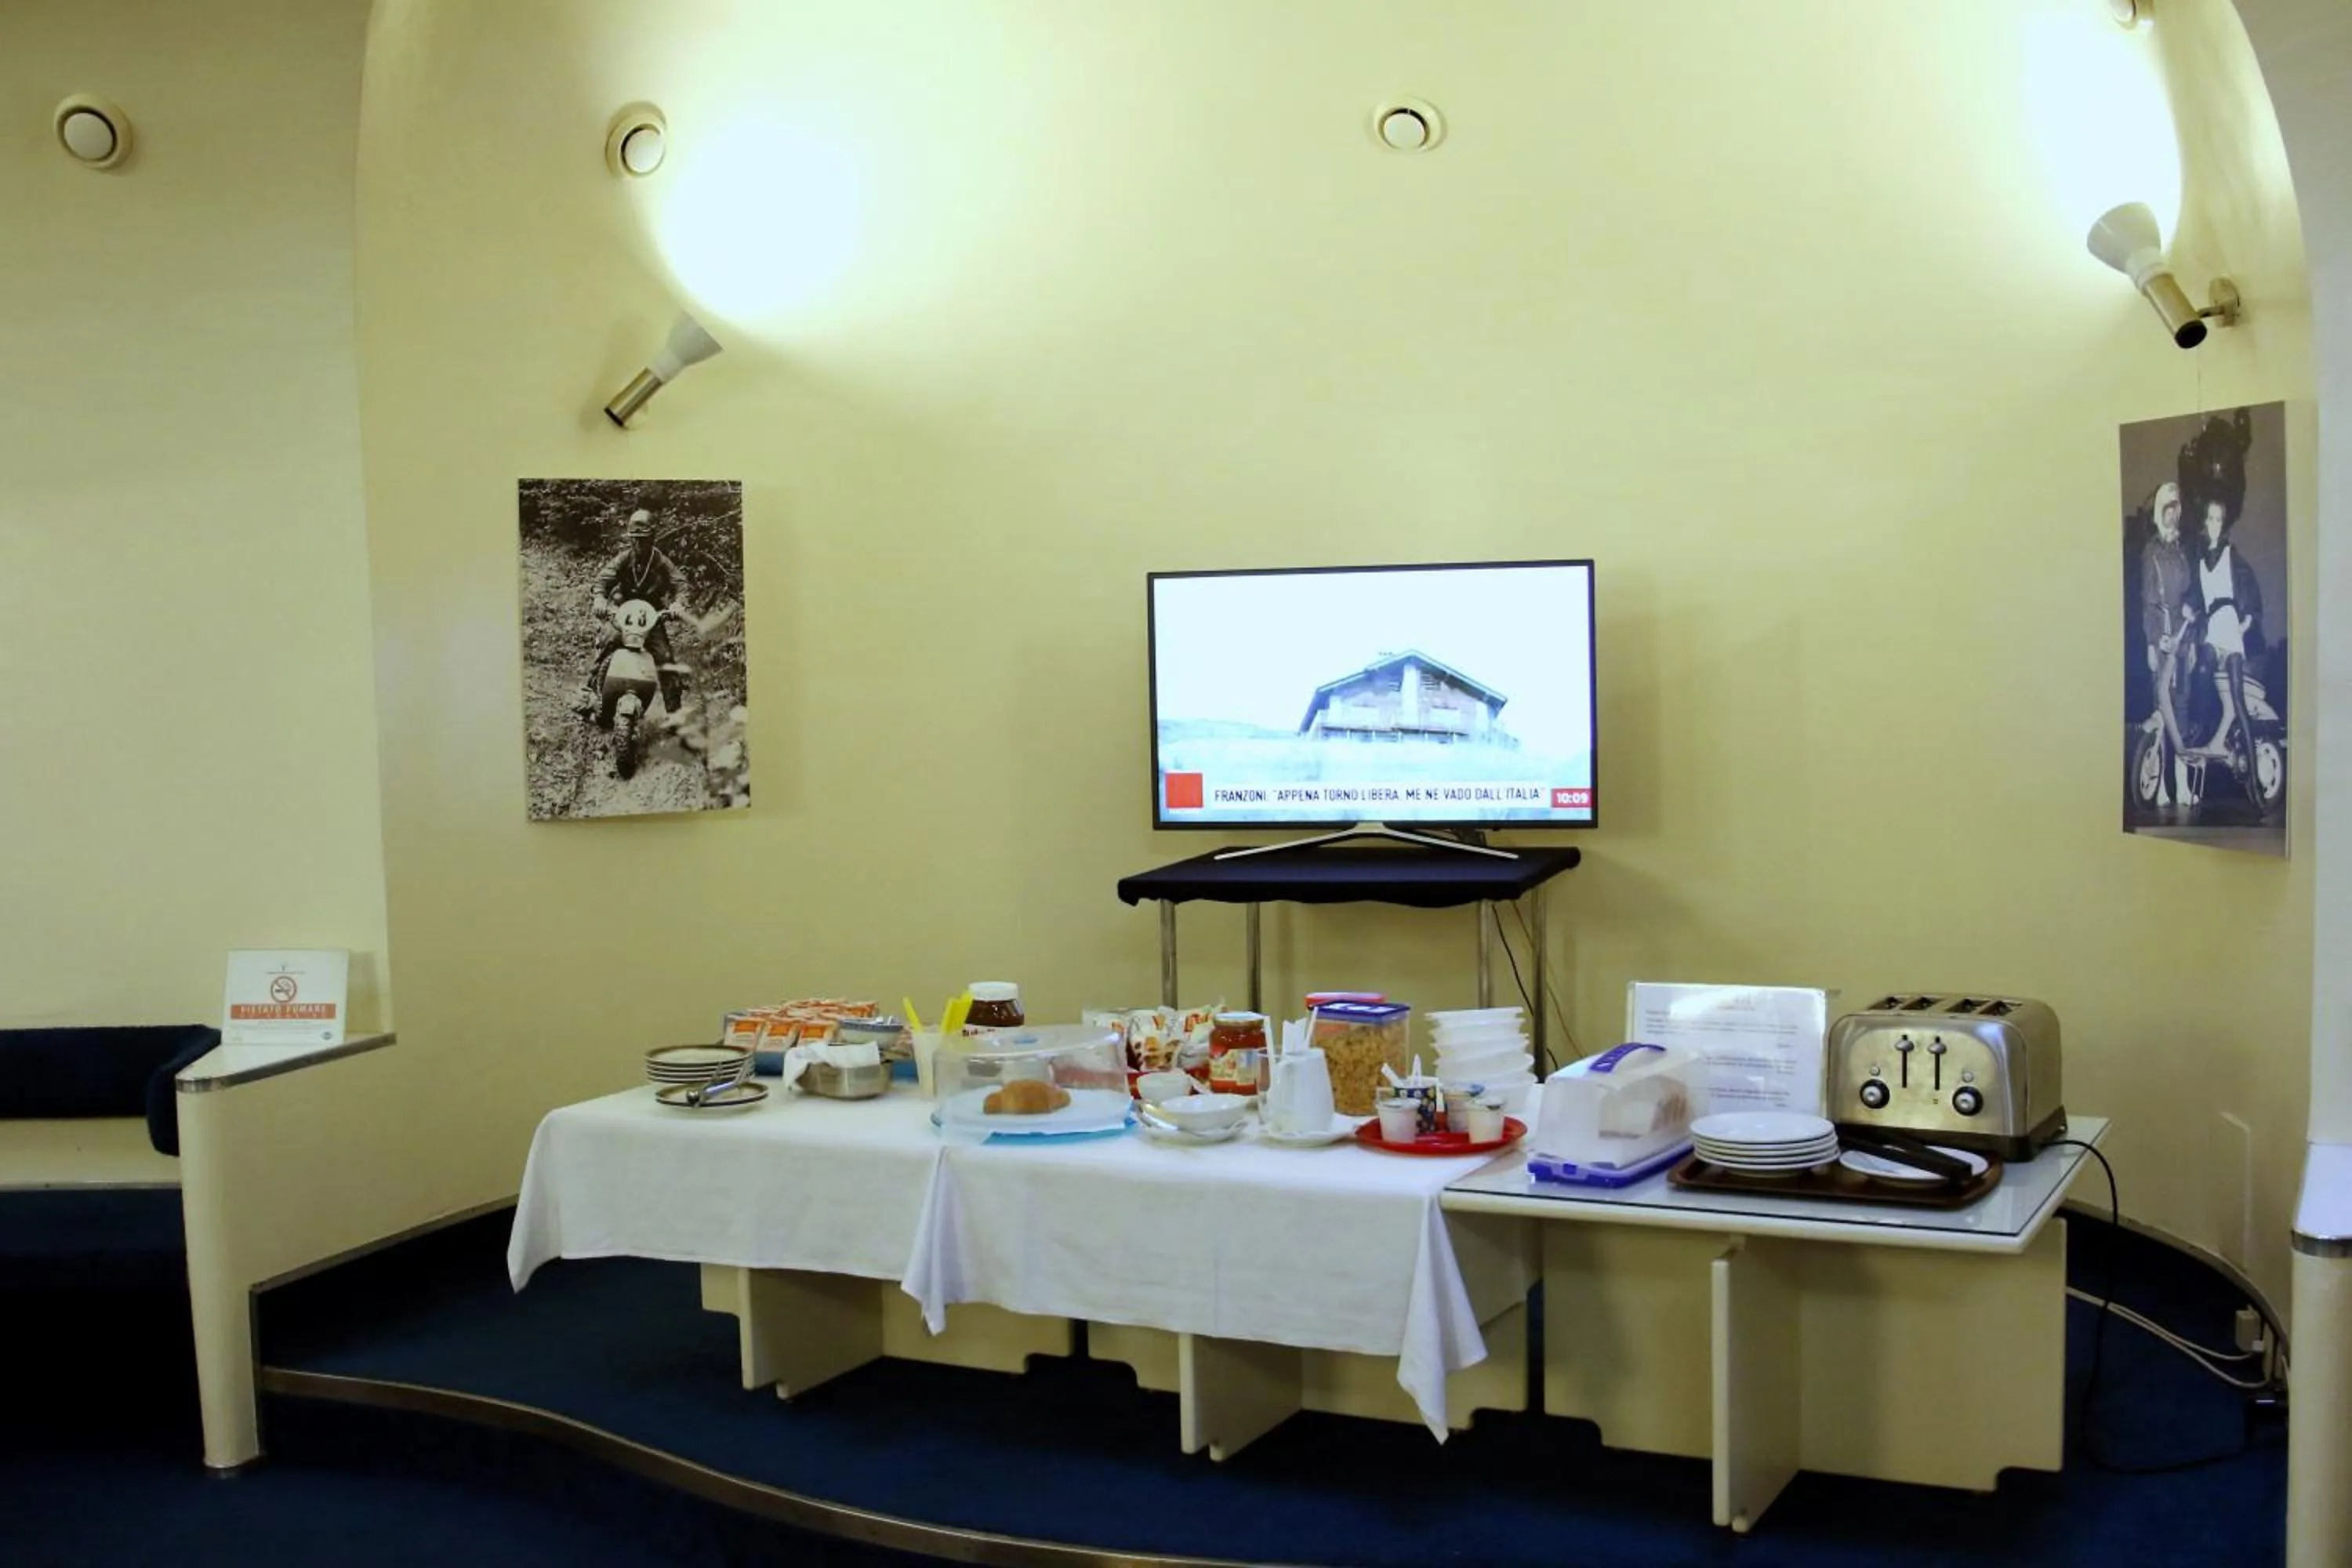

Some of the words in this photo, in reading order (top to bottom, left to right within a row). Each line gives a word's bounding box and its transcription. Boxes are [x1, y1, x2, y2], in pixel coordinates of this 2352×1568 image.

[1323, 789, 1359, 801] TORNO
[1406, 788, 1421, 800] ME
[1425, 788, 1439, 800] NE
[1443, 787, 1472, 800] VADO
